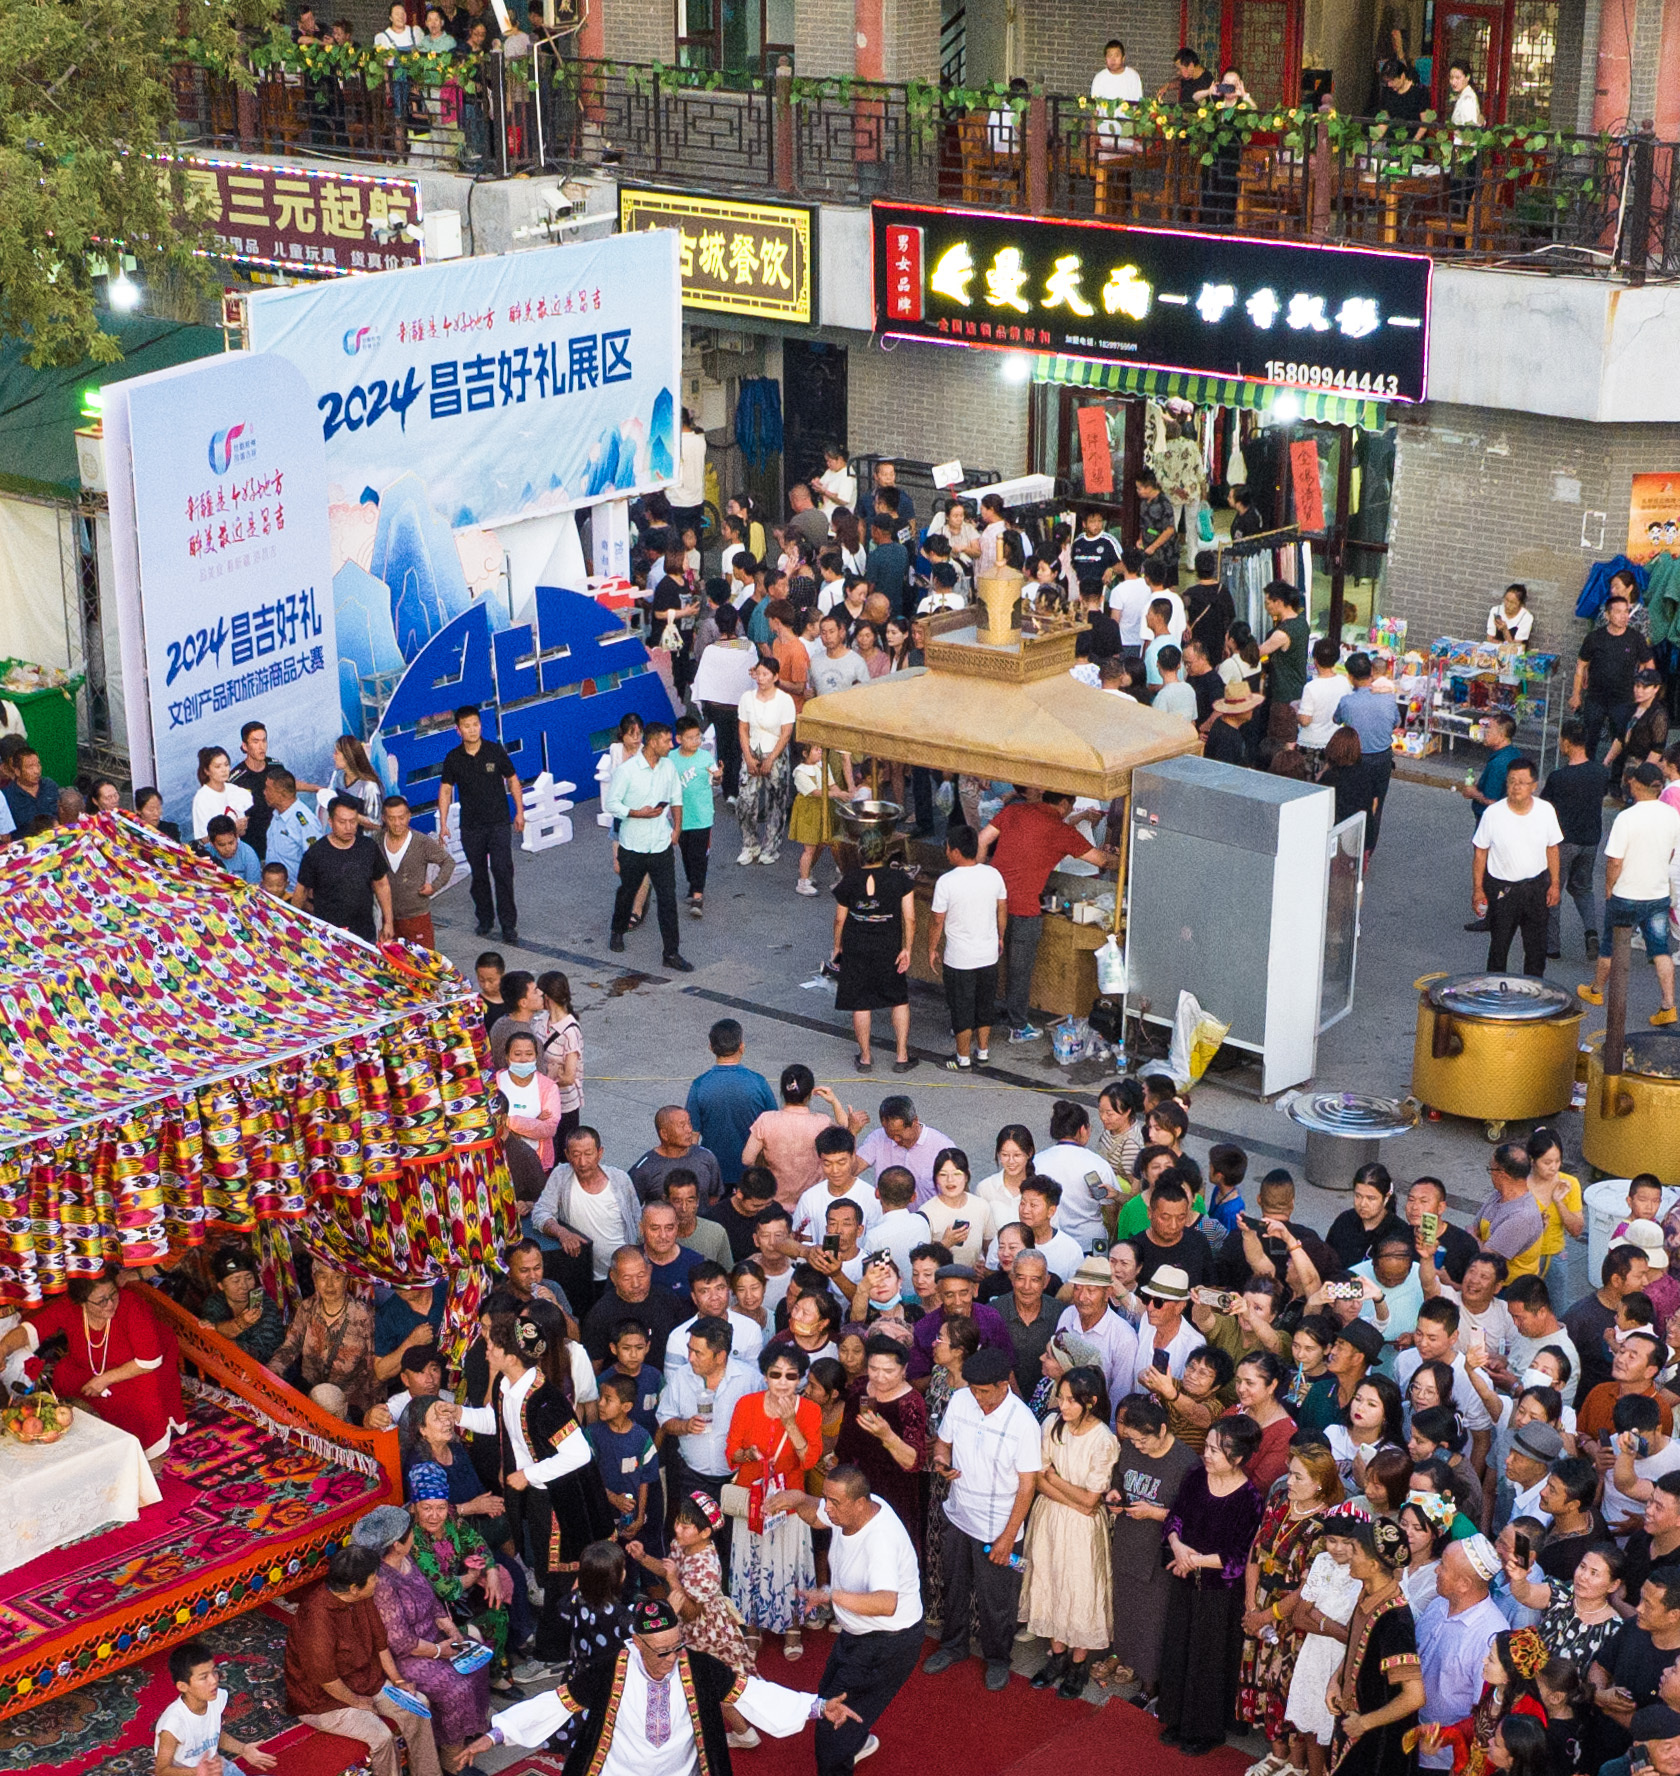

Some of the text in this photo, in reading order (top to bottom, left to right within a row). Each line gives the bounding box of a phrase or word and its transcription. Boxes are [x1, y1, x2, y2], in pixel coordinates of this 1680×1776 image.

[274, 241, 337, 264] 儿童玩具
[895, 234, 913, 315] 男女品牌
[1264, 360, 1399, 396] 15809944443
[167, 645, 325, 731] 文创产品和旅游商品大赛
